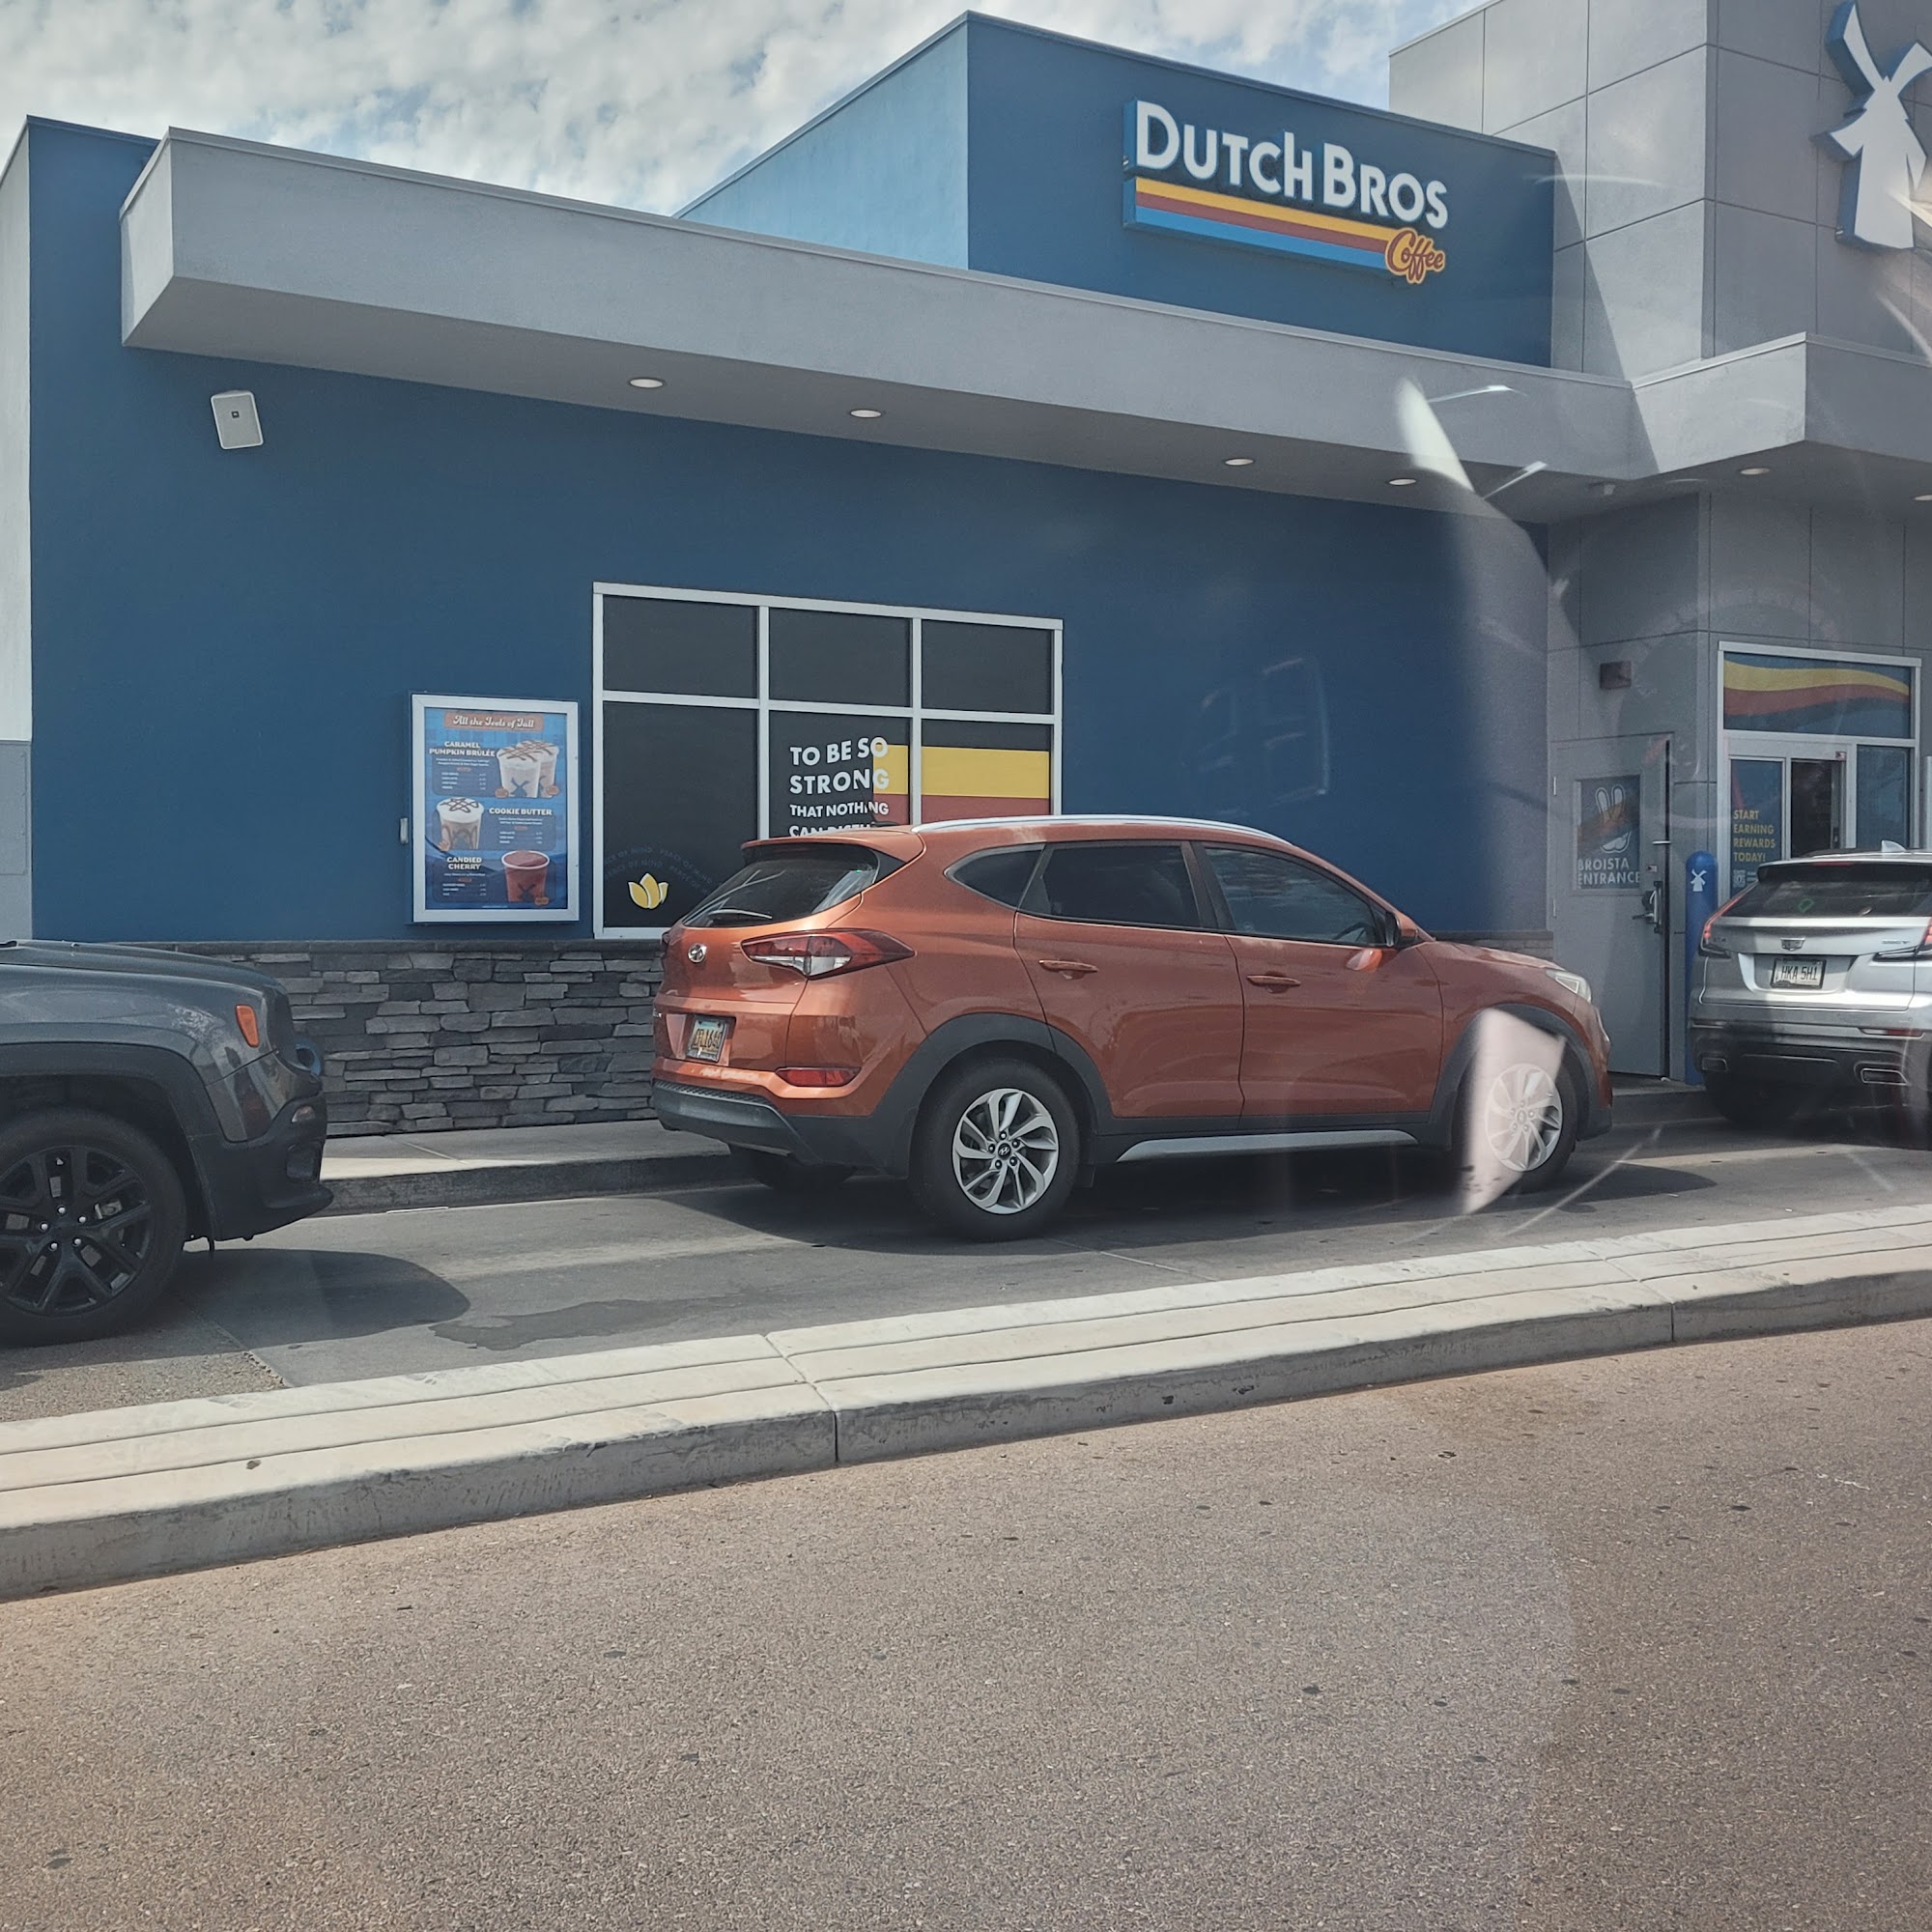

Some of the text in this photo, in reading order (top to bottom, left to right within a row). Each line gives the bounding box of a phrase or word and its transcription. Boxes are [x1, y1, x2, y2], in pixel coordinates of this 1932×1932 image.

[1322, 143, 1449, 229] BROS
[1387, 230, 1444, 283] Coffee
[453, 714, 469, 724] All
[469, 717, 483, 725] the
[507, 720, 516, 729] of
[789, 736, 888, 766] TO BE SO
[789, 768, 890, 795] STRONG
[789, 805, 823, 818] THAT
[1733, 810, 1759, 820] START
[1733, 823, 1775, 835] EARNING
[1733, 838, 1776, 848] REWARDS
[1577, 857, 1630, 871] BROISTA
[1733, 852, 1766, 862] TODAY!
